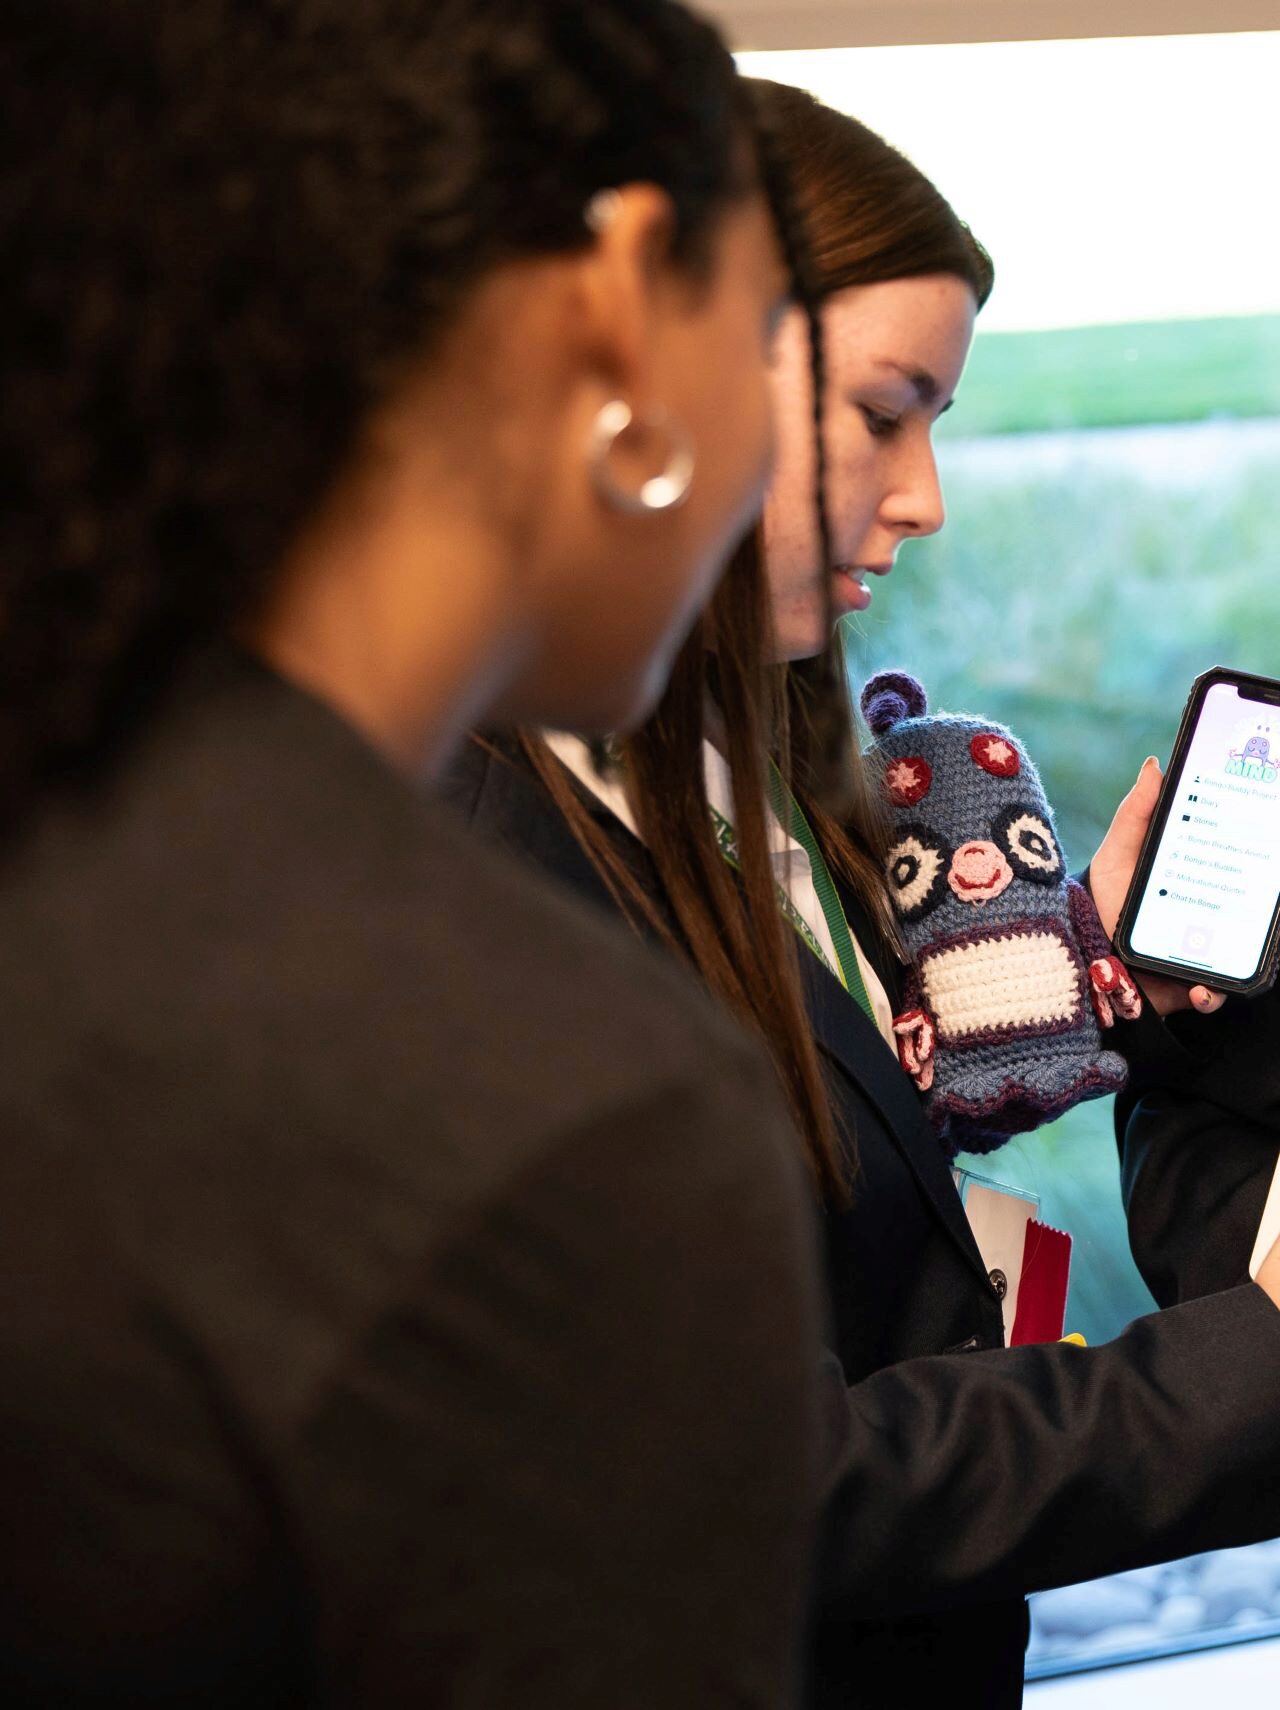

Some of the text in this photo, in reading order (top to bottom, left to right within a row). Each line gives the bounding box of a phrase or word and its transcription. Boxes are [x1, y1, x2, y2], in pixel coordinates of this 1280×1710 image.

[1225, 758, 1278, 784] MIND
[1194, 816, 1218, 827] Stories
[1188, 835, 1210, 846] Bongo
[1170, 891, 1187, 903] Chat
[1197, 898, 1221, 911] Bongo
